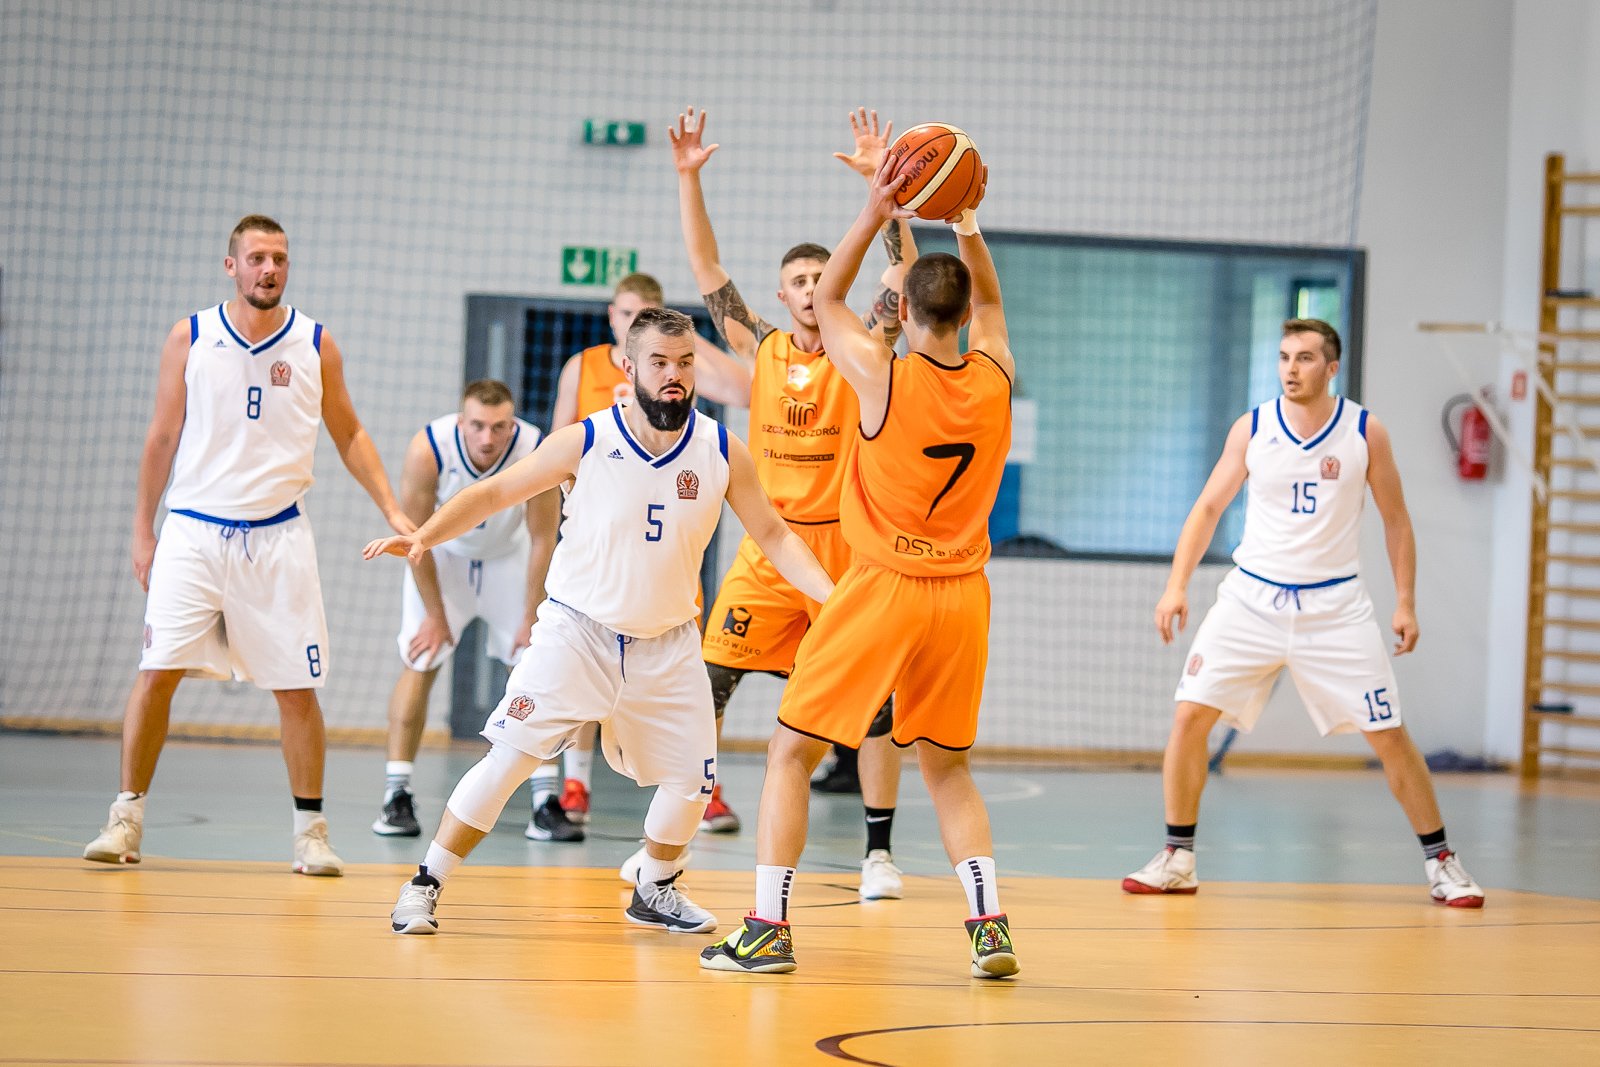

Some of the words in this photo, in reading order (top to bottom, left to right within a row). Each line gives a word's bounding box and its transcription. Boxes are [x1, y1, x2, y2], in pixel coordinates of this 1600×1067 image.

[247, 386, 262, 420] 8
[922, 442, 976, 522] 7
[1291, 482, 1318, 514] 15
[645, 503, 665, 542] 5
[306, 644, 321, 678] 8
[1364, 687, 1393, 722] 15
[701, 757, 715, 795] 5
